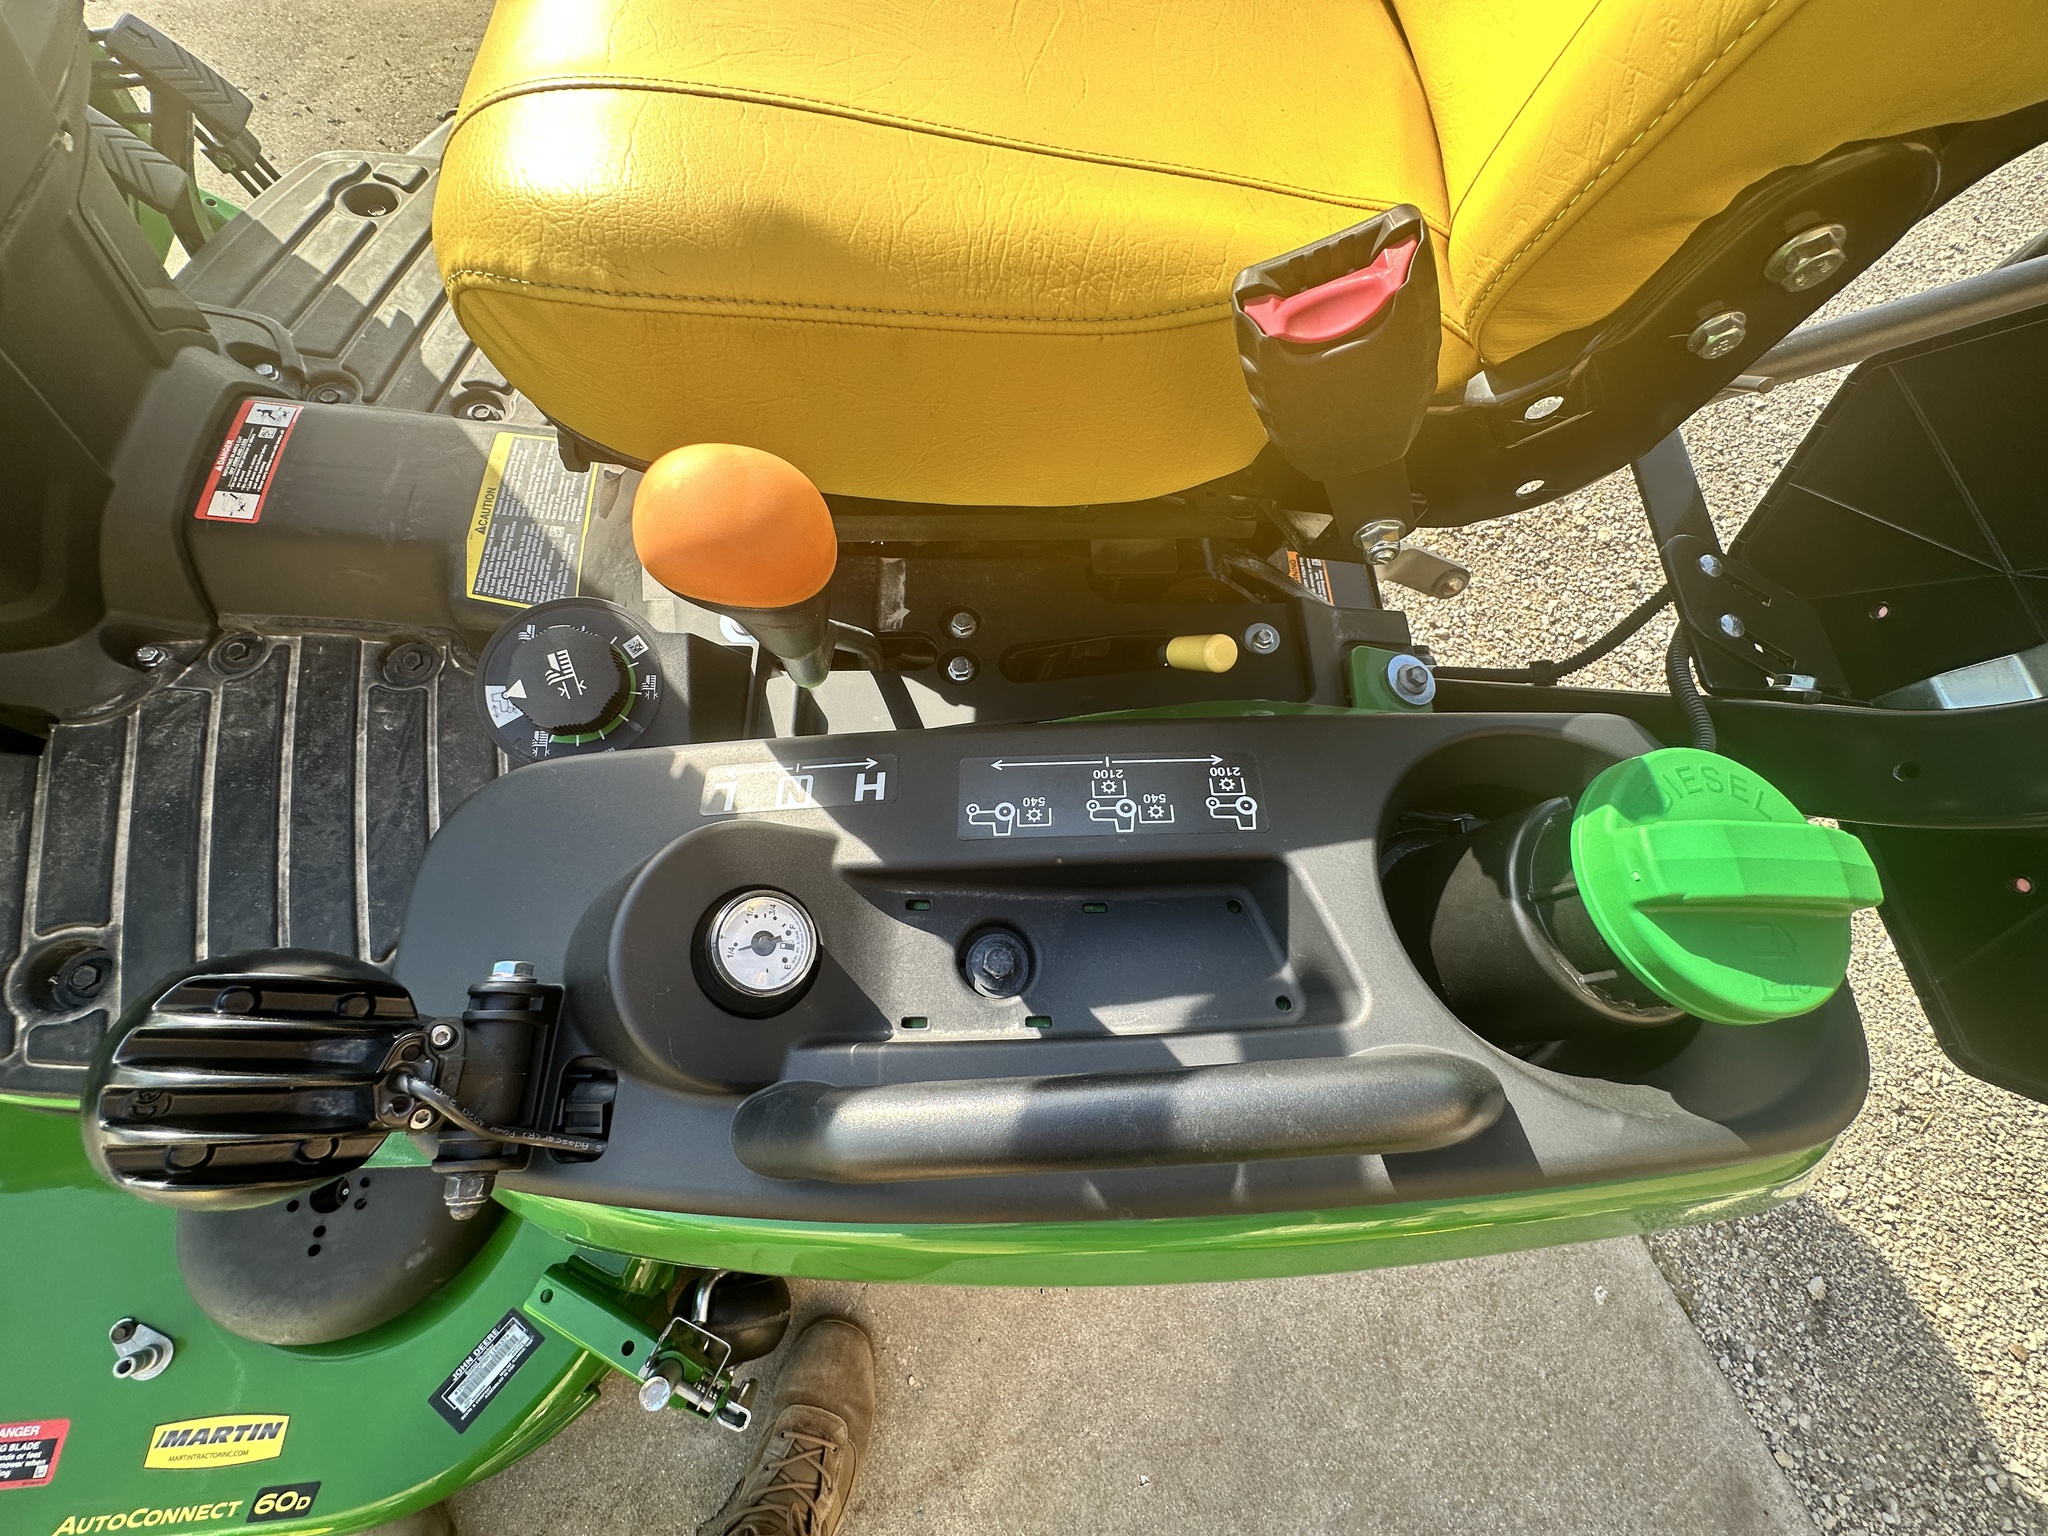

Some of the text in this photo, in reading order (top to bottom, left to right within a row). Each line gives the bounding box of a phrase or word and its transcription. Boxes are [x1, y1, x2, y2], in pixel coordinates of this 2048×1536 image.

[217, 439, 235, 467] DANGER
[478, 487, 497, 527] CAUTION
[1290, 559, 1299, 581] RNING
[1092, 768, 1124, 779] 2100
[1209, 766, 1241, 777] 2100
[854, 771, 887, 802] H
[1646, 765, 1773, 820] DIESEL
[1023, 796, 1046, 807] 540
[1142, 793, 1167, 804] 540
[746, 906, 754, 917] 1/2
[727, 947, 735, 958] 1/4
[450, 1356, 473, 1381] JOHN
[472, 1327, 499, 1356] DEERE
[155, 1421, 283, 1448] MARTIN
[8, 1441, 41, 1451] BLADE
[168, 1449, 249, 1462] MARTINTRACTORINC.COM
[253, 1490, 312, 1515] 60D
